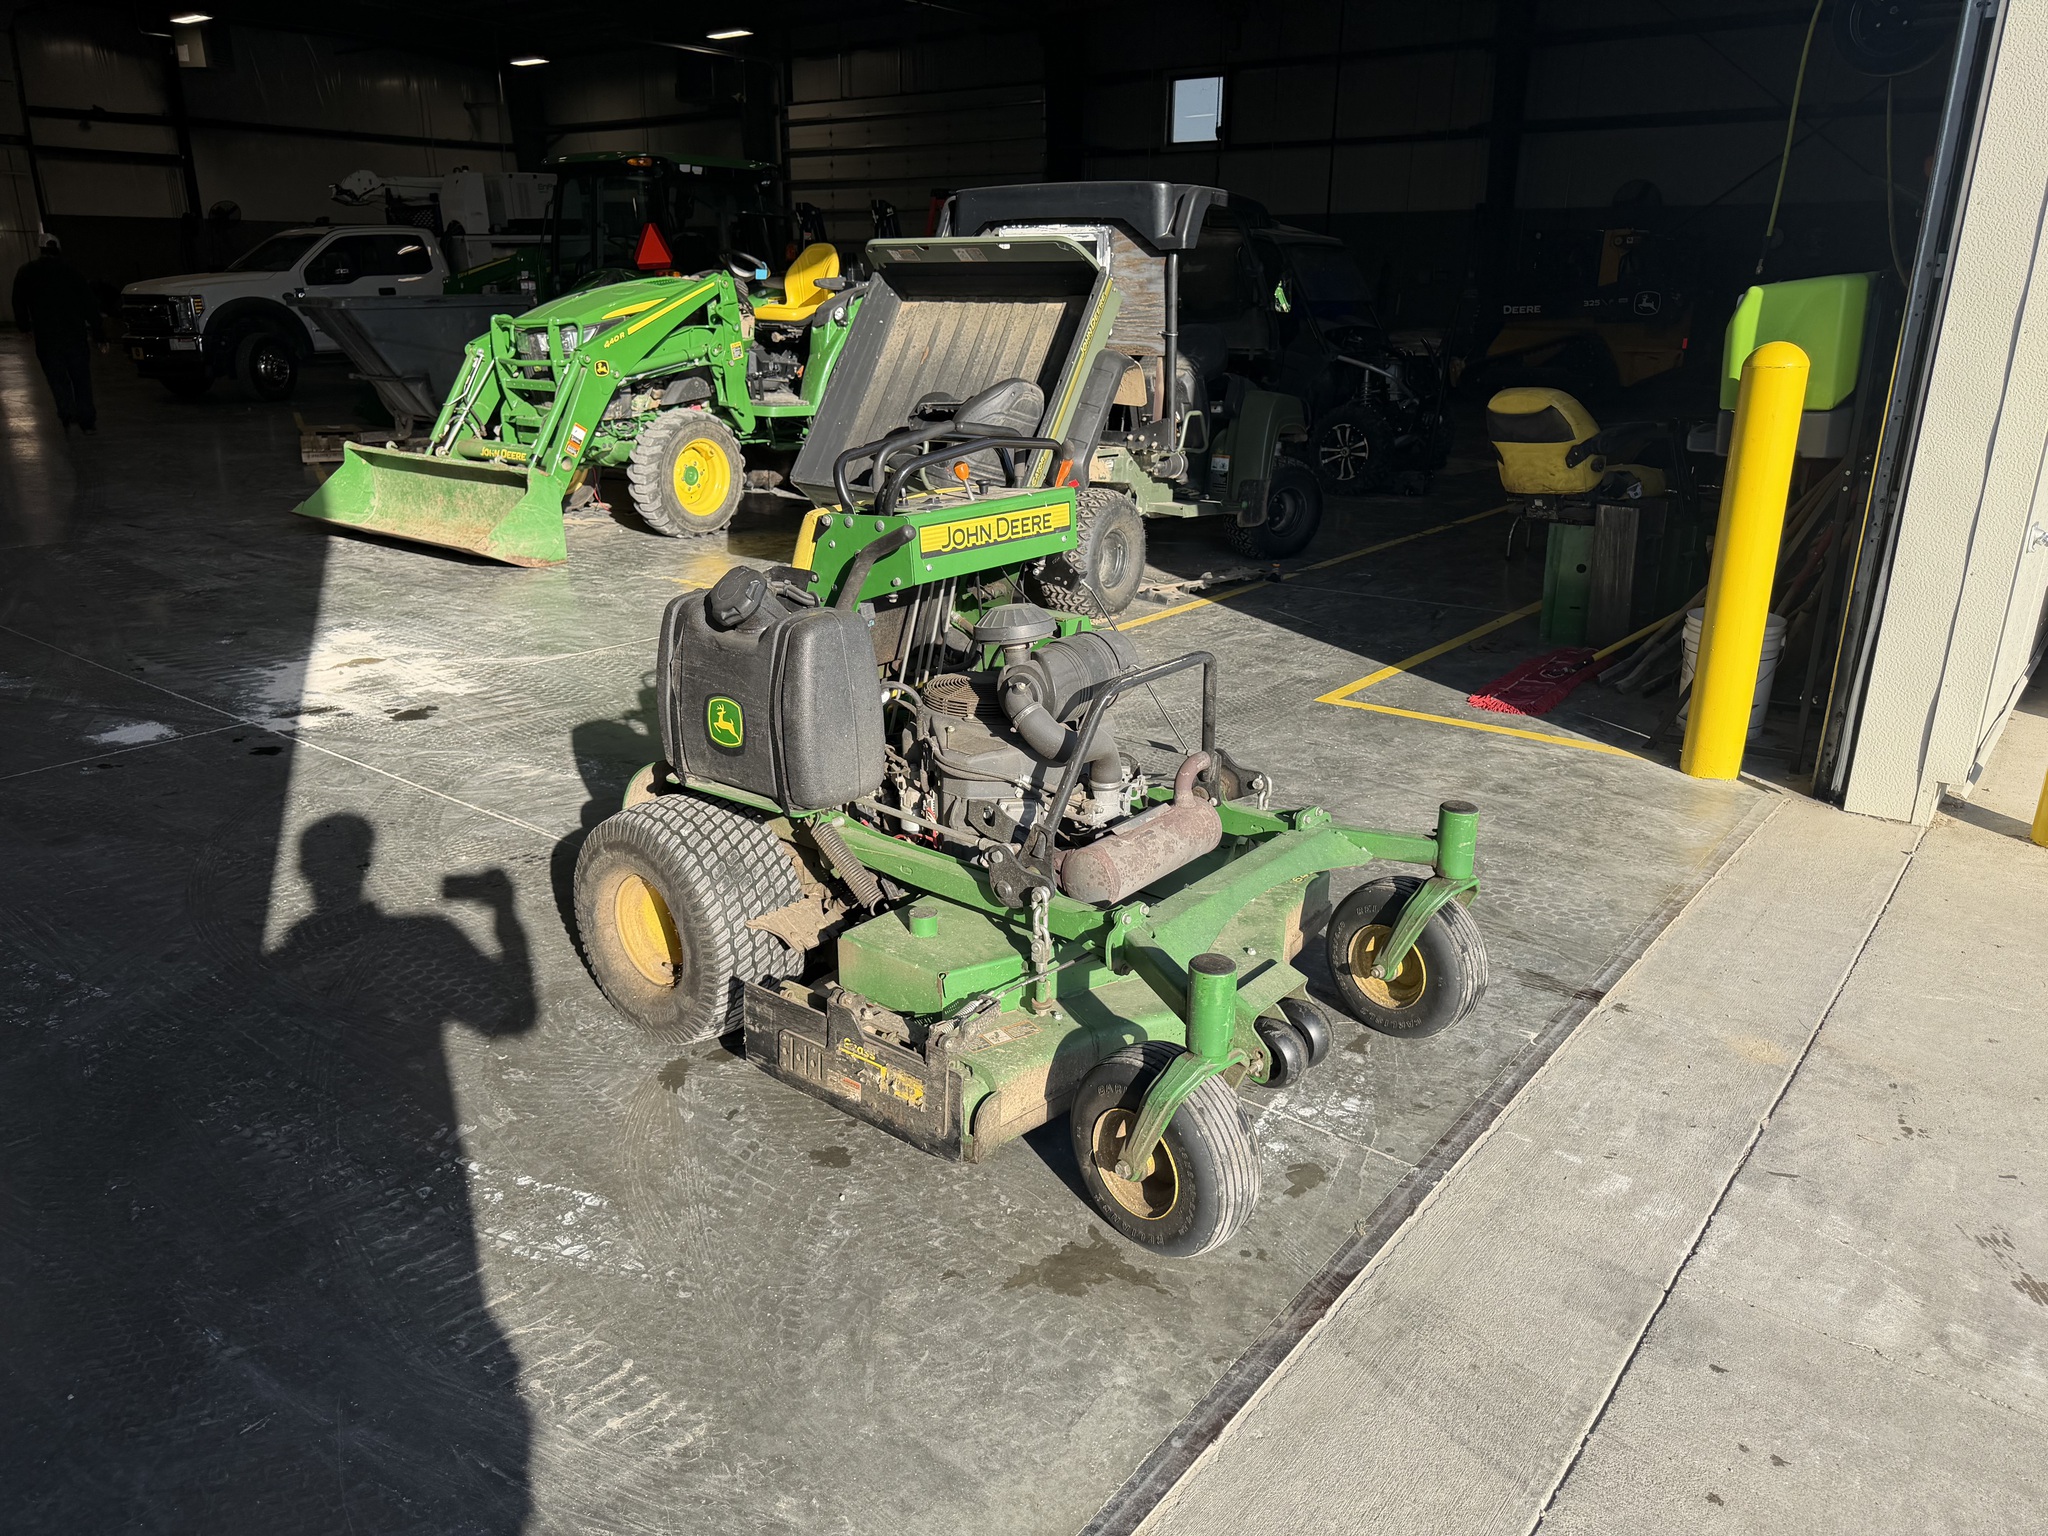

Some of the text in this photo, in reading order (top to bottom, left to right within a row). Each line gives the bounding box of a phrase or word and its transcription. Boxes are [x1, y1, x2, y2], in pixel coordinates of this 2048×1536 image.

[1503, 305, 1541, 314] DEERE
[480, 447, 527, 461] JOHN DEERE
[942, 513, 1052, 549] JOHN DEERE
